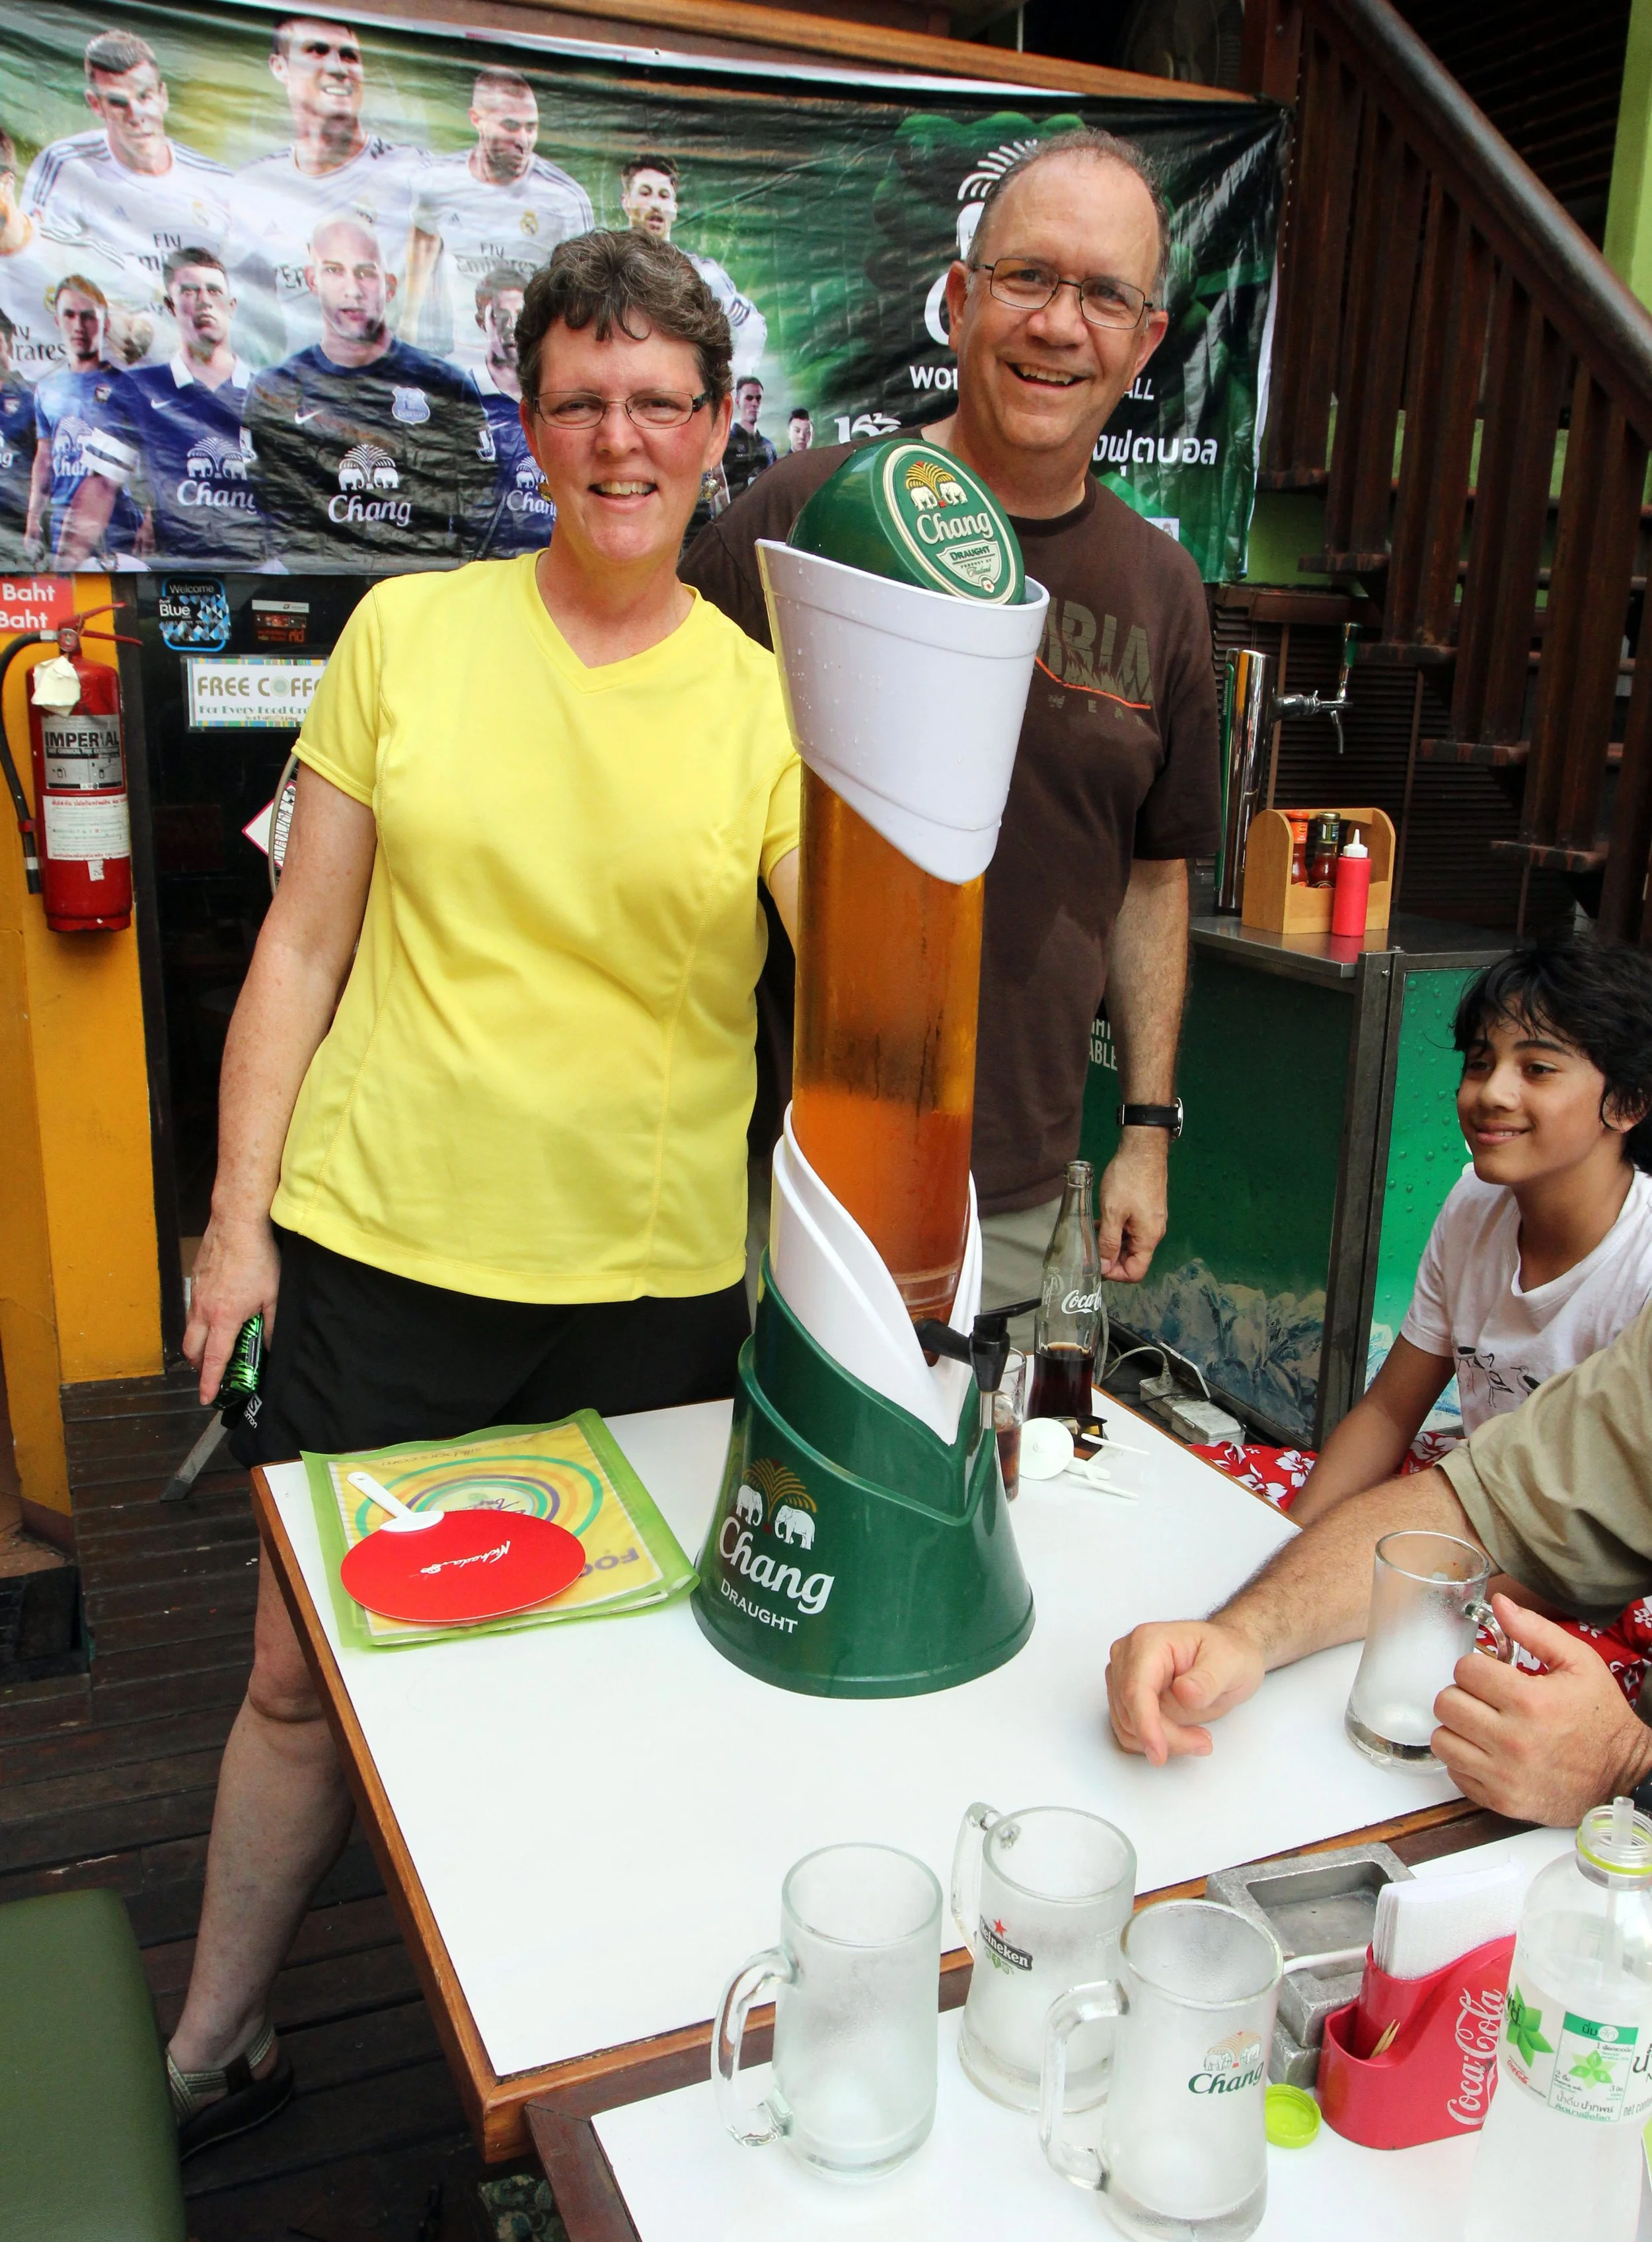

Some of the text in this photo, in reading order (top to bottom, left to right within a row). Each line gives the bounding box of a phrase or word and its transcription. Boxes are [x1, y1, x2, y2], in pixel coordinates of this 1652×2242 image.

[328, 494, 412, 527] Chang
[917, 512, 995, 545] Chang
[950, 545, 991, 560] DRAUGHT
[2, 582, 56, 602] Baht
[169, 584, 215, 594] Welcome
[0, 608, 48, 629] Baht
[160, 603, 191, 617] Blue
[198, 676, 321, 697] FREE COFF
[200, 705, 218, 714] For
[222, 705, 254, 716] Every
[45, 731, 119, 748] IMPERIAL
[719, 1516, 835, 1615] Chang
[720, 1578, 798, 1633] DRAUGHT
[980, 1918, 1029, 1968] Heineken
[1446, 1987, 1505, 2126] Coca-Cola
[1188, 2061, 1265, 2095] Chang
